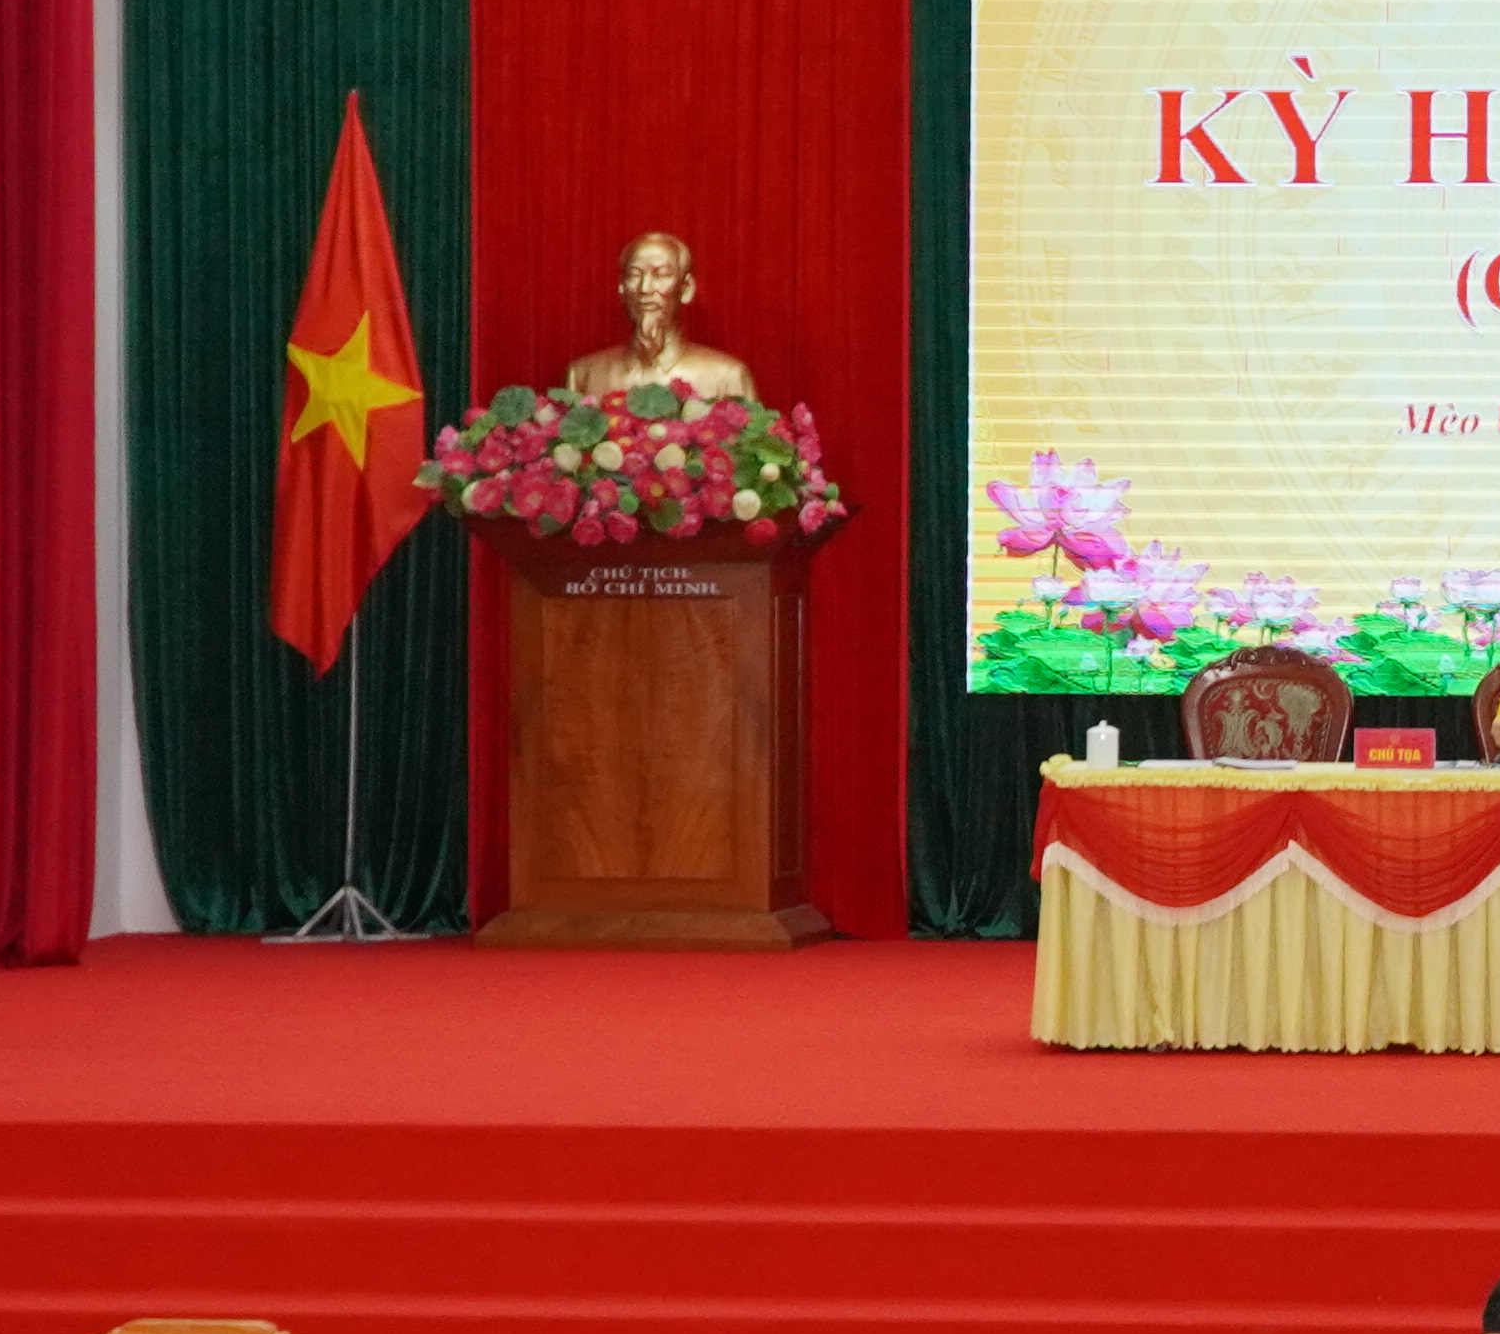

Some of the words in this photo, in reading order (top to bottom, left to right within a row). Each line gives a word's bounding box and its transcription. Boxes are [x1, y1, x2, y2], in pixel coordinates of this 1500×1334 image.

[1145, 53, 1357, 188] KỲ
[1398, 400, 1481, 437] Mèo
[589, 565, 634, 579] CHỦ
[639, 567, 693, 581] TỊCH
[565, 577, 598, 595] HỒ
[603, 578, 645, 595] CHÍ
[653, 581, 722, 596] MINH
[1368, 745, 1395, 763] CHỦ
